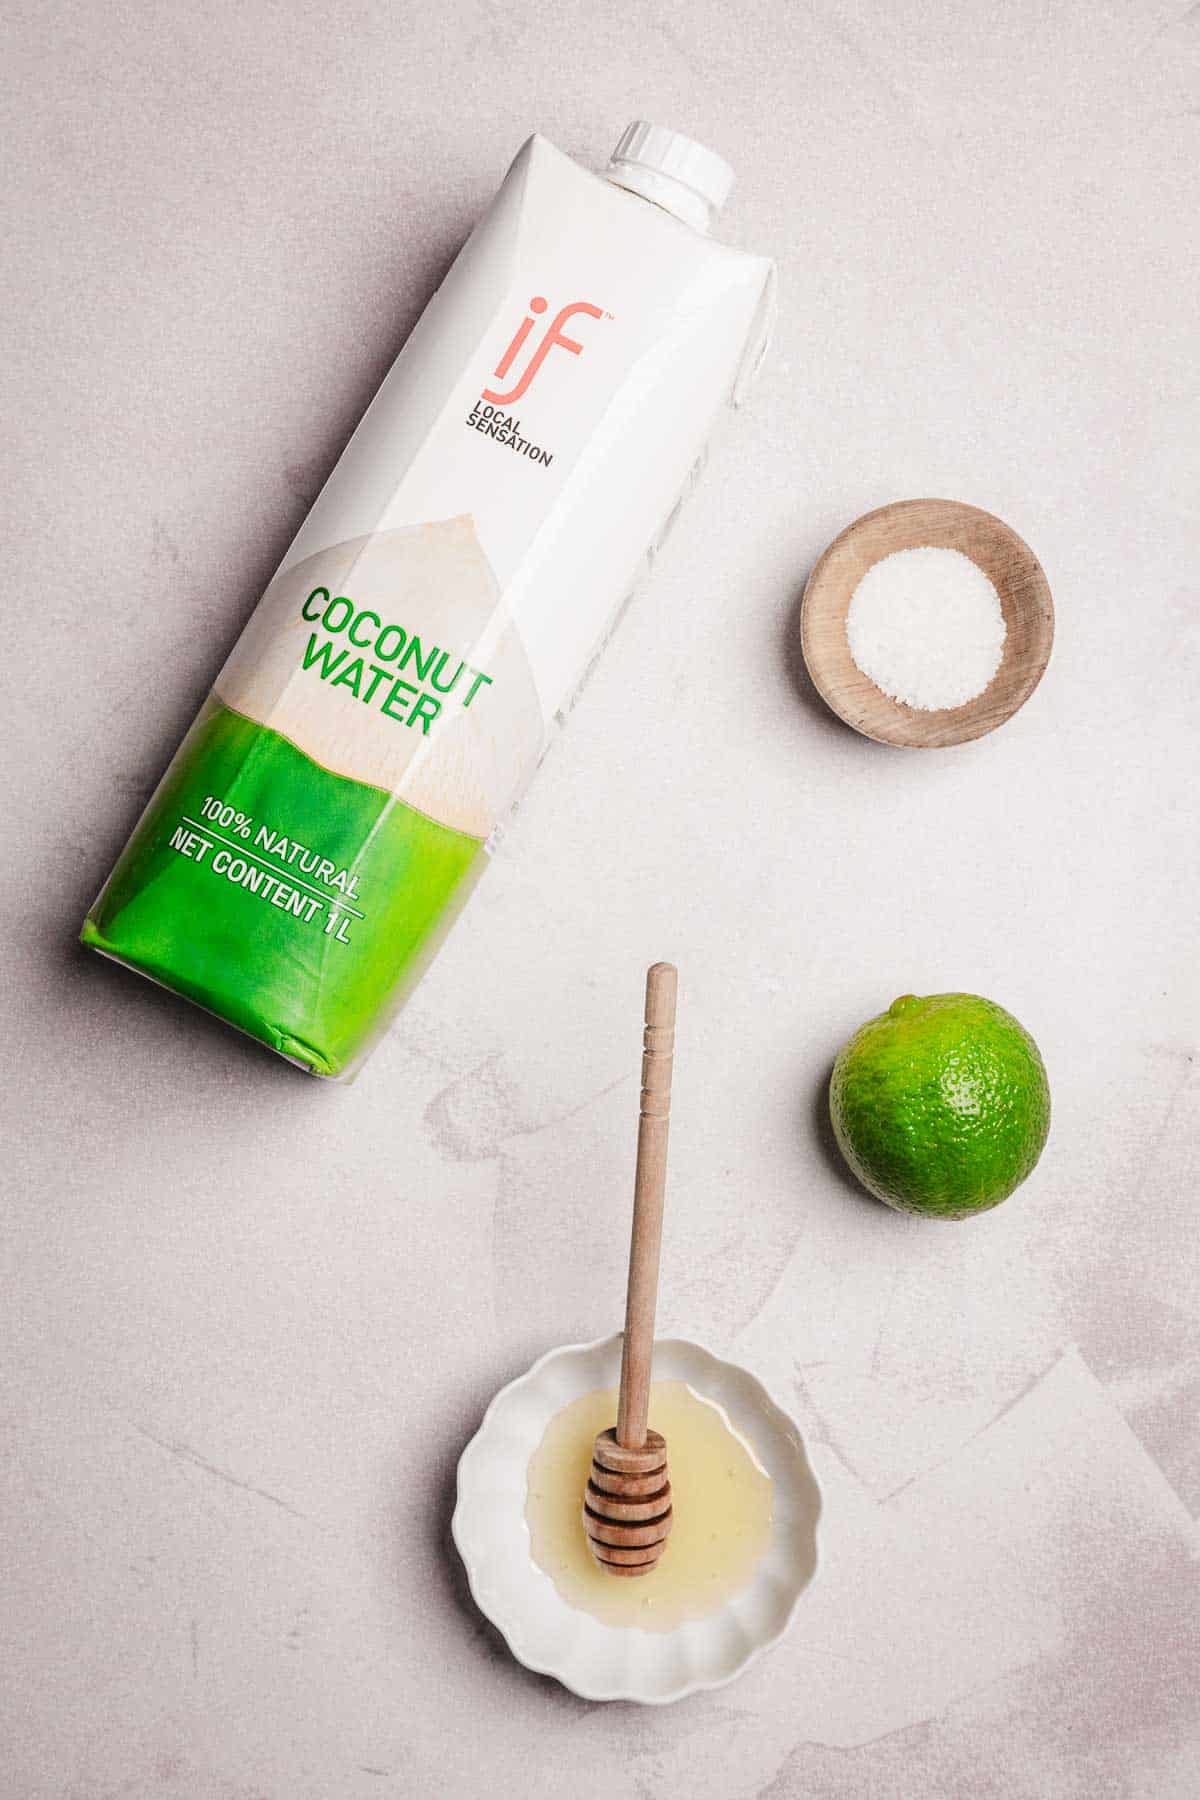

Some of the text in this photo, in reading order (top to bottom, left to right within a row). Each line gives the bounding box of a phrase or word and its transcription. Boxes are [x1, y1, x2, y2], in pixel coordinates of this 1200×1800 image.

[481, 297, 603, 405] if
[466, 413, 553, 467] SENSATION
[473, 400, 521, 435] LOCAL
[302, 586, 493, 707] COCONUT
[302, 633, 442, 735] WATER
[169, 826, 214, 863] NET
[212, 851, 323, 923] CONTENT
[201, 797, 360, 900] 100% NATURAL
